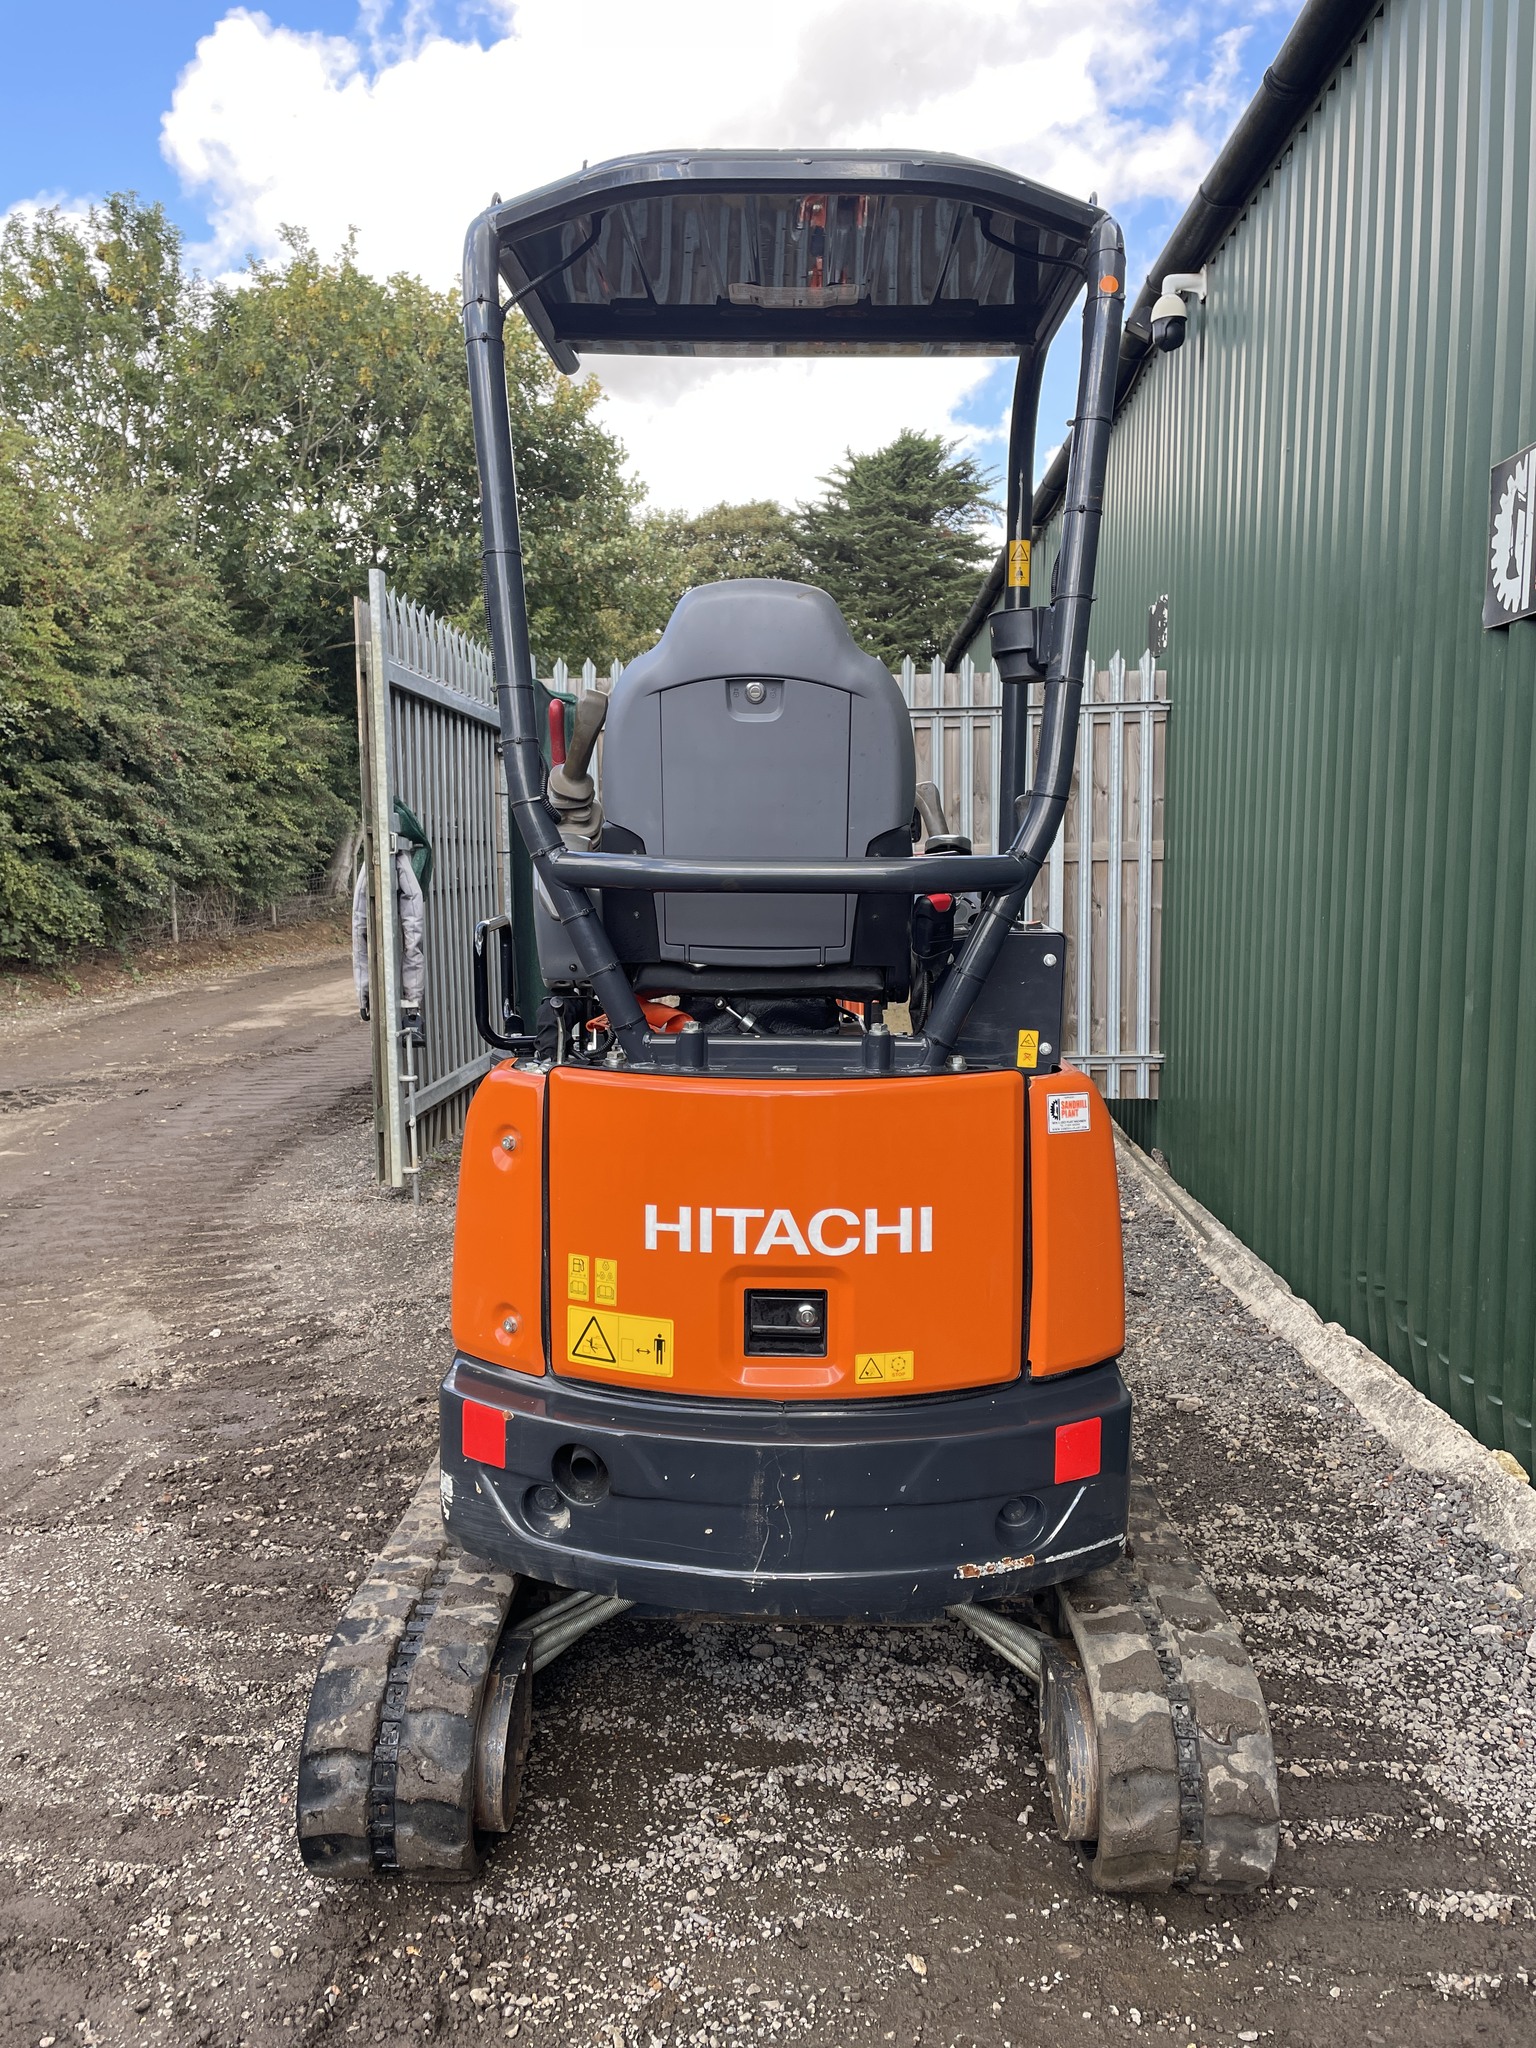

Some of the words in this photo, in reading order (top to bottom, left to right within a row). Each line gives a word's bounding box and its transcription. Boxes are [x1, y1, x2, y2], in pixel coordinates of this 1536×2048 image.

[1061, 1100, 1087, 1109] SANDHILL
[1061, 1109, 1079, 1118] PLANT
[645, 1204, 933, 1256] HITACHI
